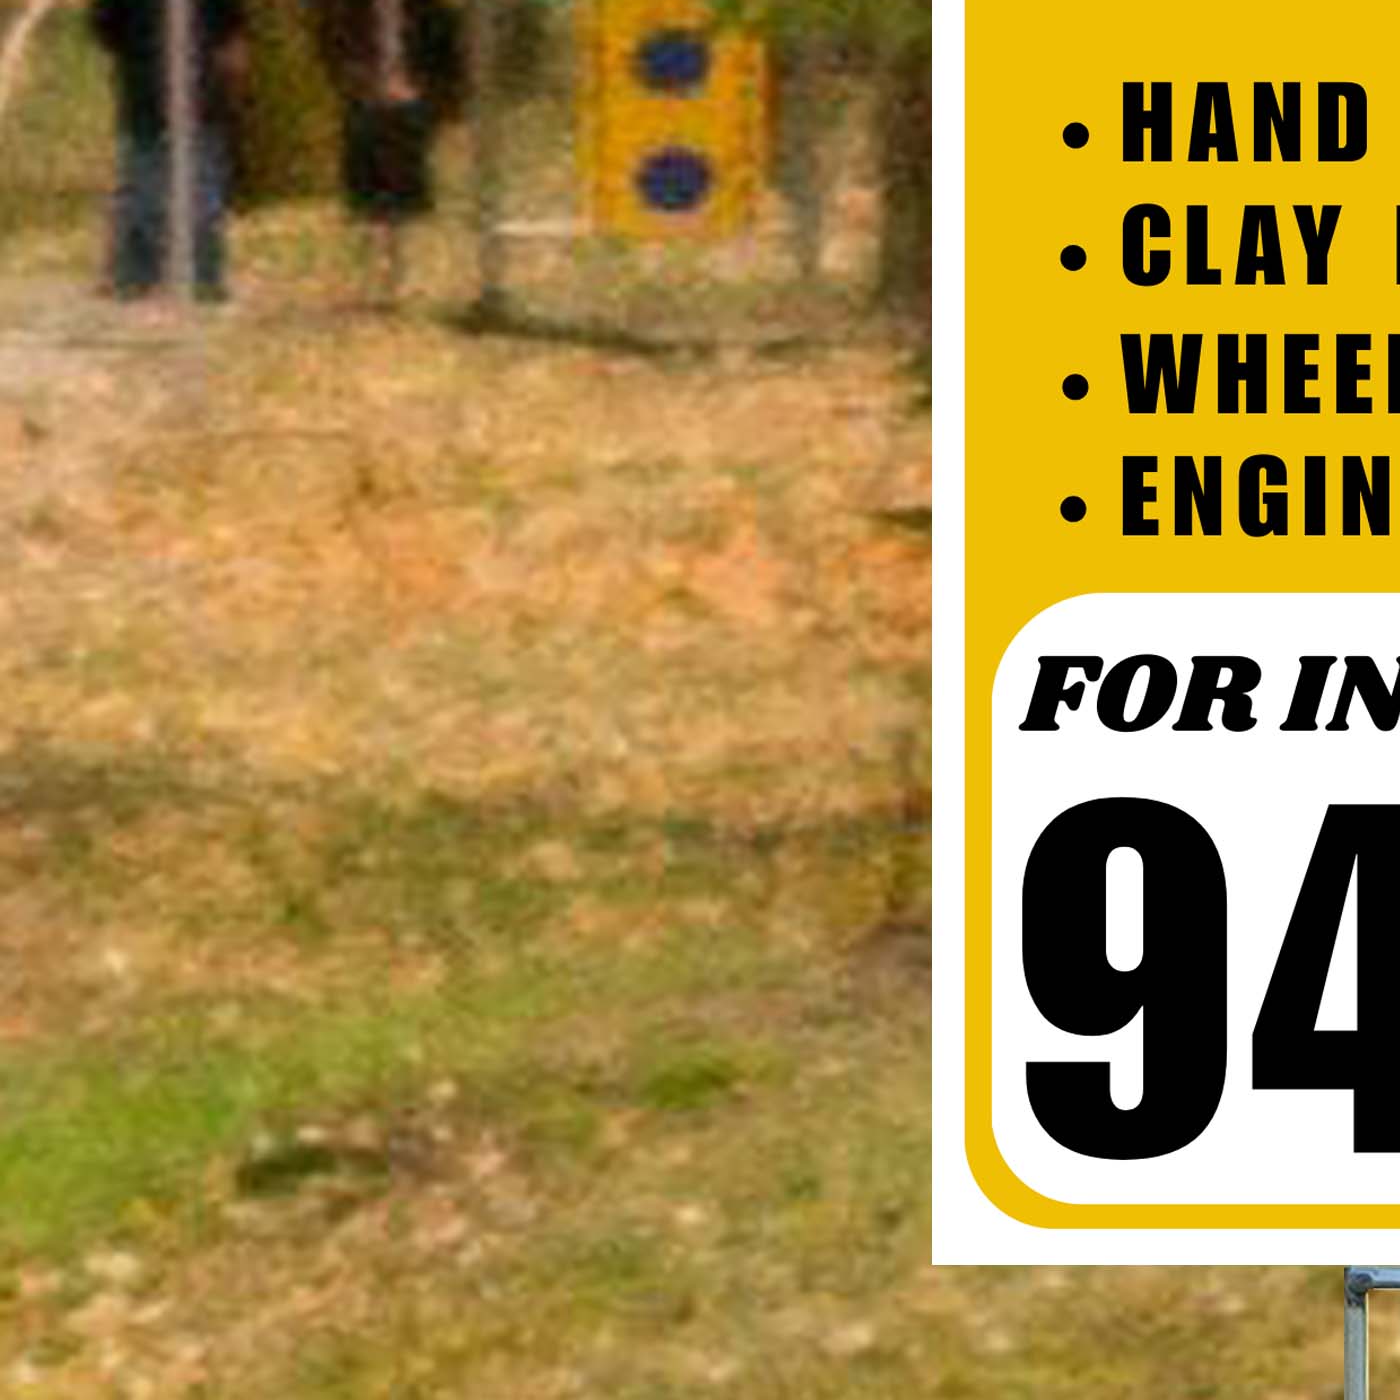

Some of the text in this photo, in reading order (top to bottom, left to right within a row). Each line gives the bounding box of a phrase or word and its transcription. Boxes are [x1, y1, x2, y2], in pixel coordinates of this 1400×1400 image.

[1122, 81, 1368, 162] HAND
[1122, 203, 1342, 287] CLAY
[1018, 654, 1262, 733] FOR
